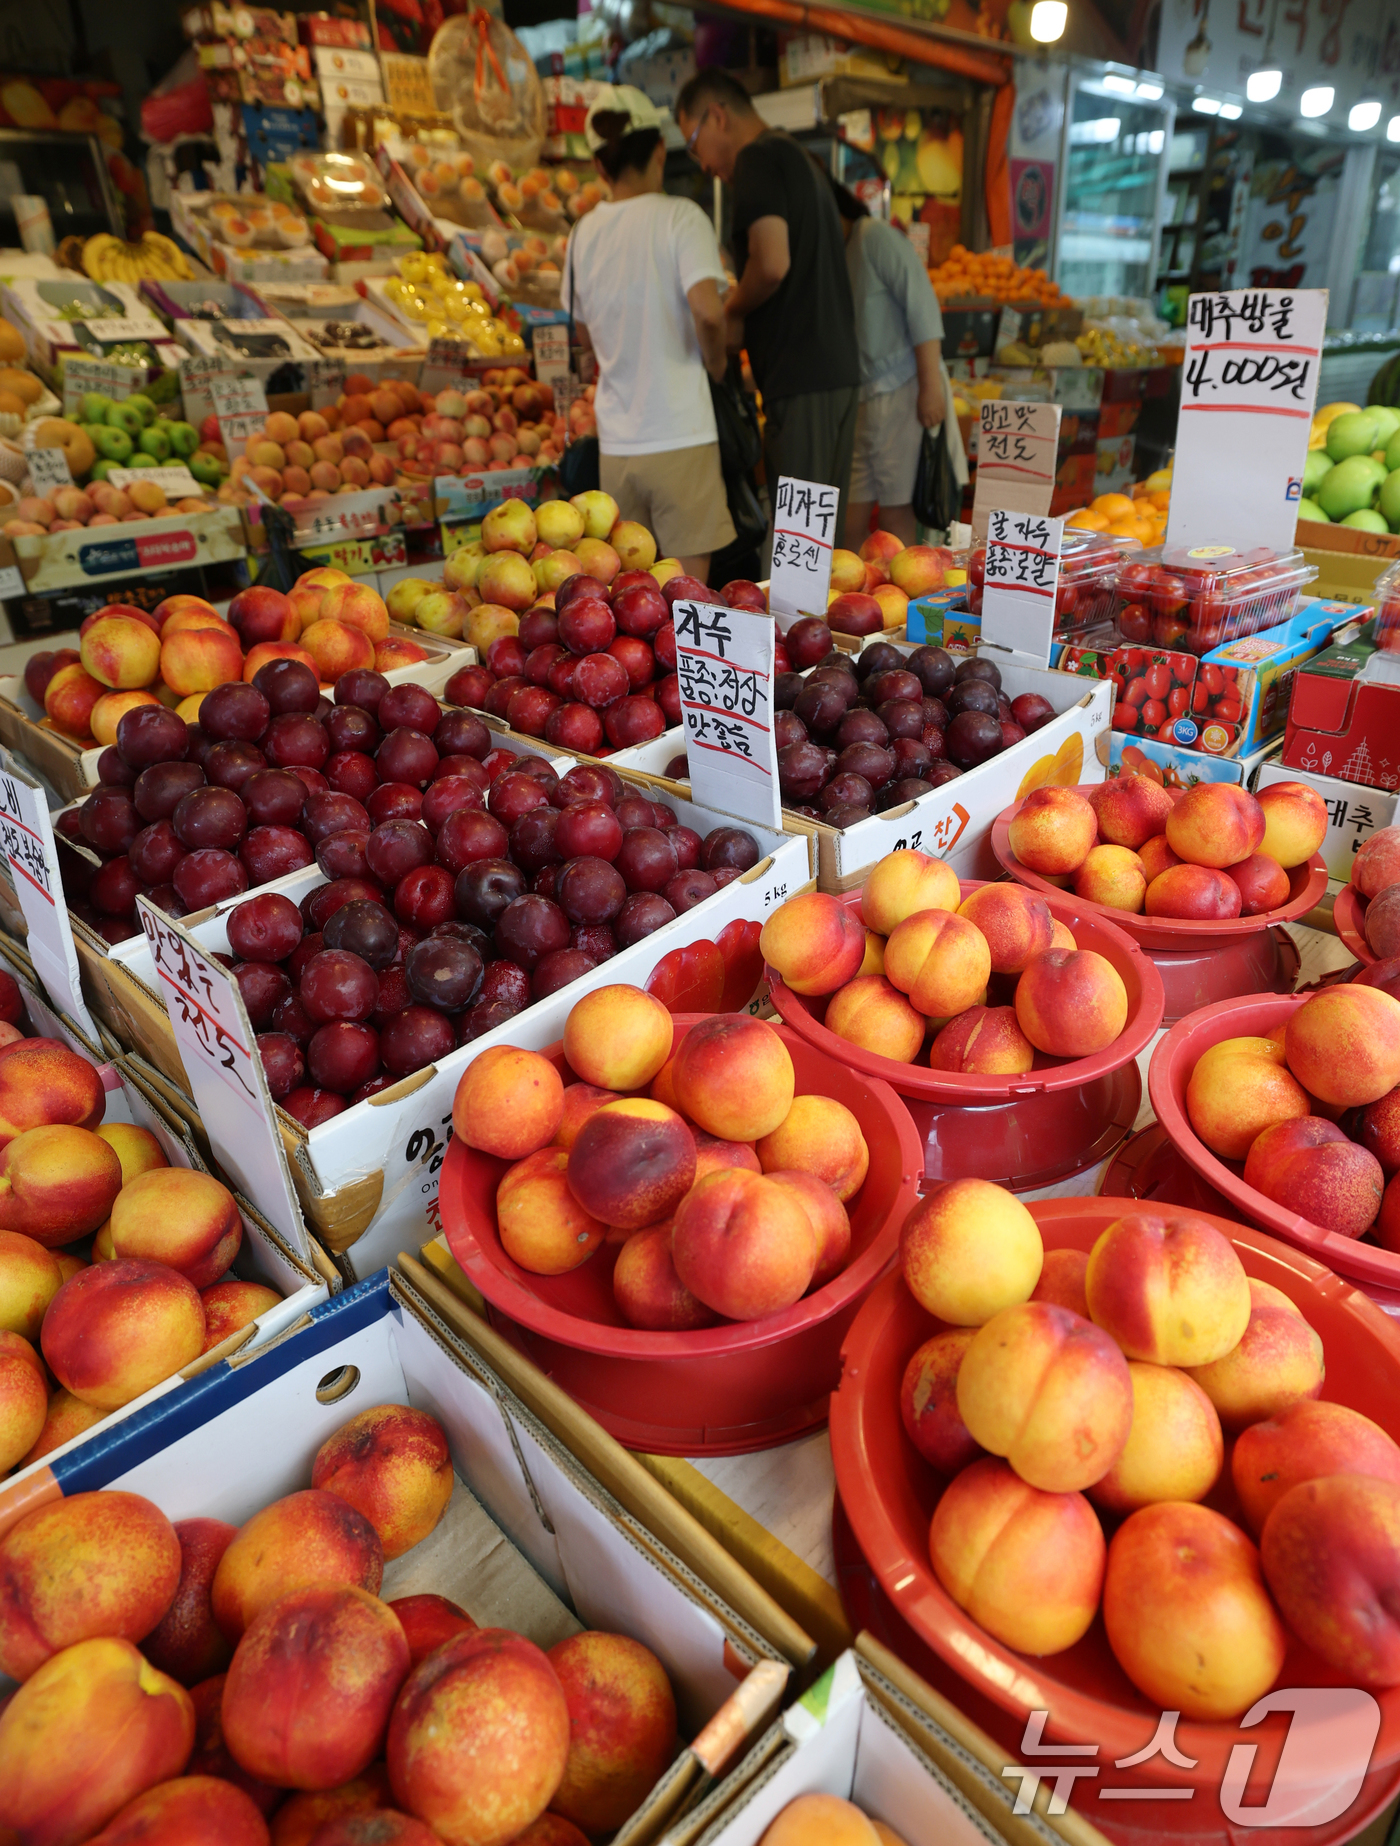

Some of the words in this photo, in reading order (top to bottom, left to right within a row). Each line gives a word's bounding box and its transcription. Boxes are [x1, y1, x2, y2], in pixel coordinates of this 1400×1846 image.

[1186, 350, 1310, 399] 4.000원
[981, 404, 1011, 432] 망고
[1015, 405, 1037, 432] 맛
[986, 434, 1037, 461] 천도
[777, 482, 835, 537] 피자두
[992, 511, 1009, 541] 꿀
[1014, 517, 1051, 549] 자두
[676, 604, 732, 657] 자두
[1178, 725, 1194, 737] 3KG
[0, 778, 23, 823] 비
[1324, 798, 1374, 833] 대추
[142, 911, 220, 1014] 맛있는
[174, 988, 257, 1099] 천도
